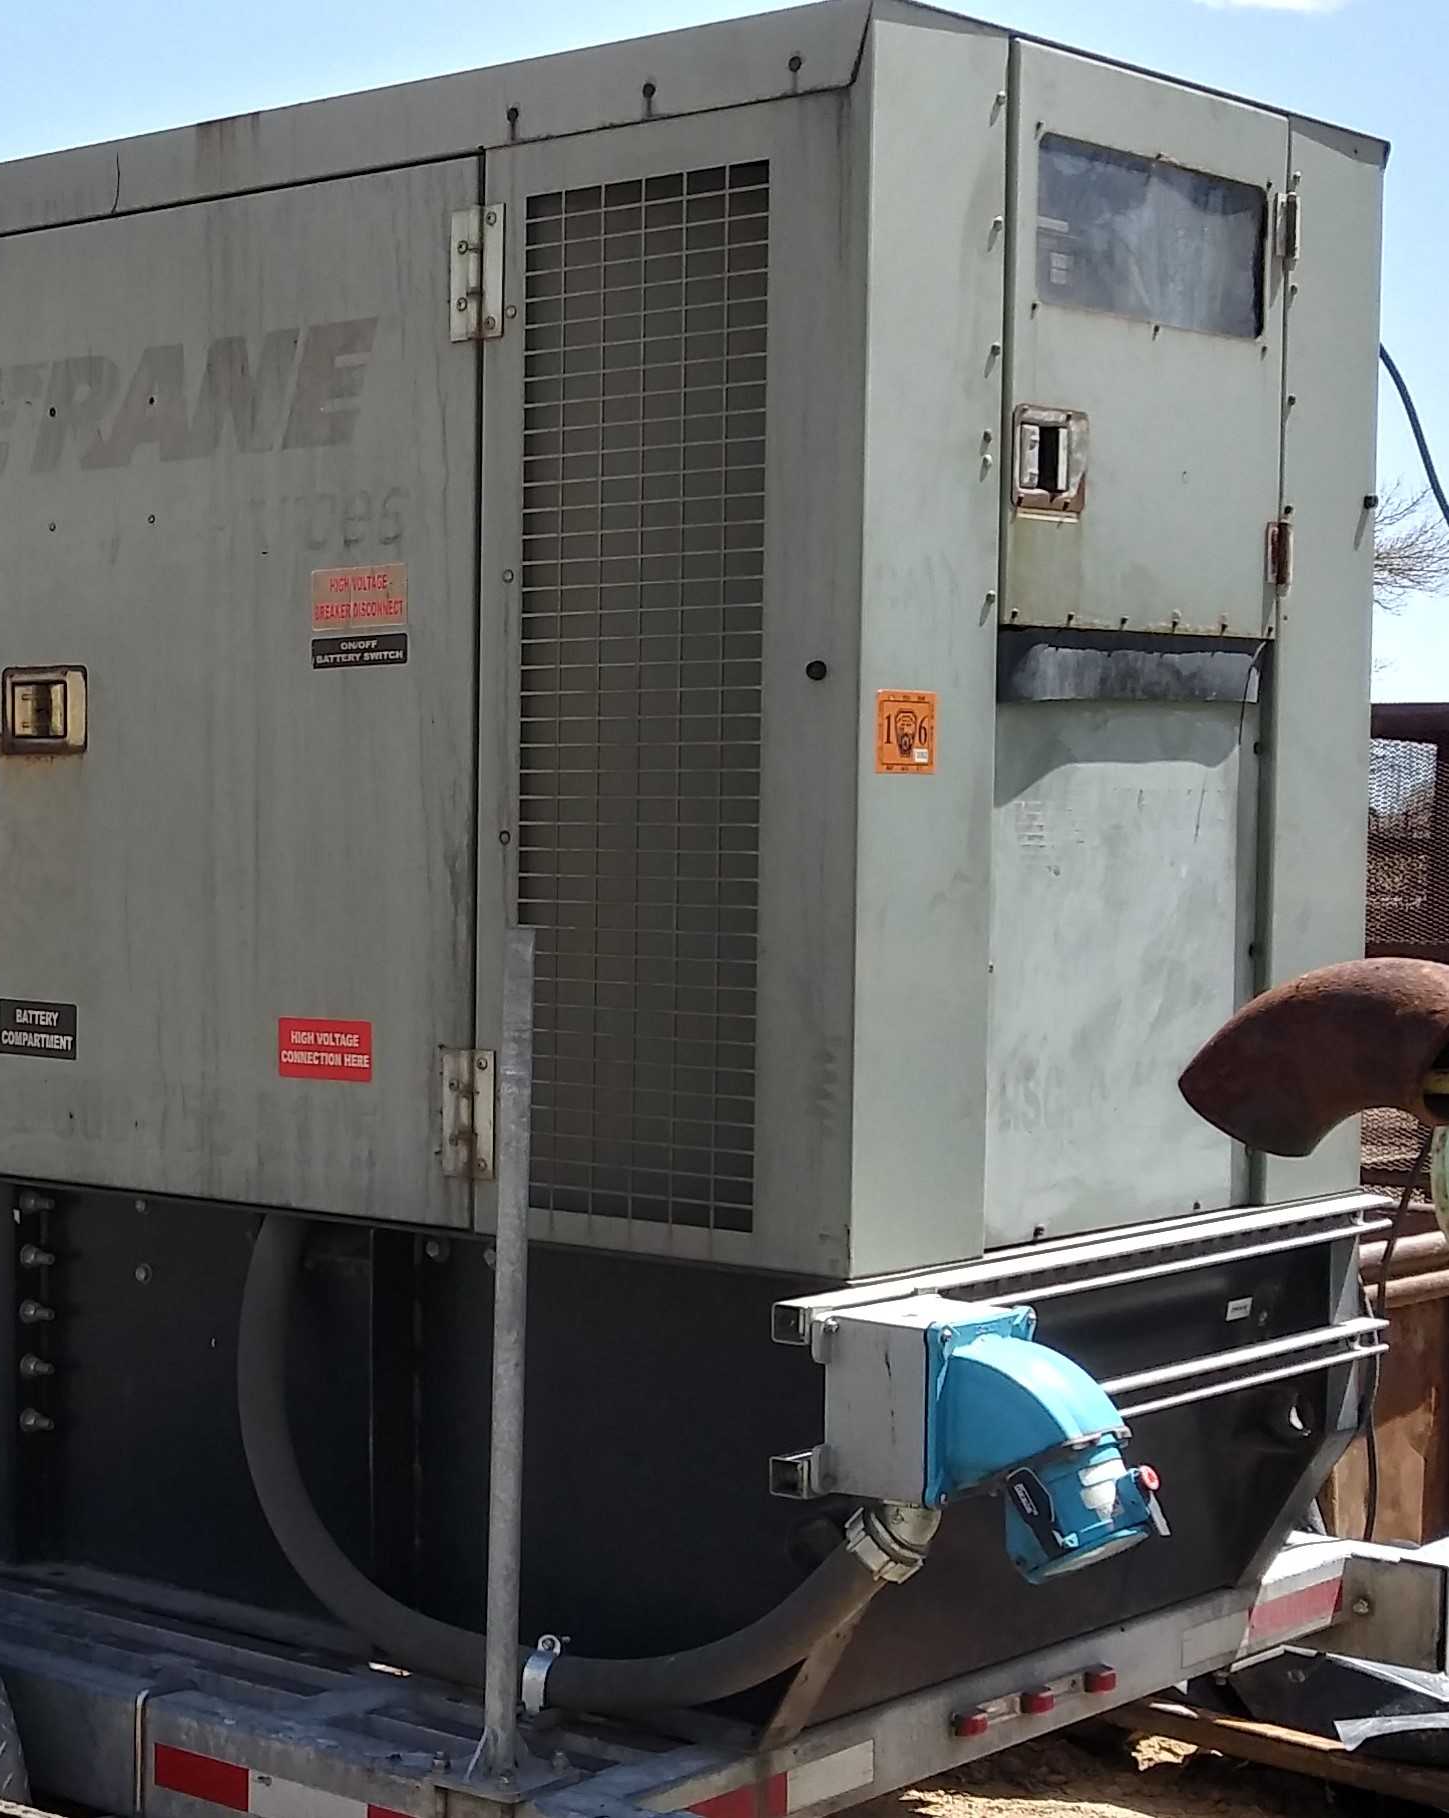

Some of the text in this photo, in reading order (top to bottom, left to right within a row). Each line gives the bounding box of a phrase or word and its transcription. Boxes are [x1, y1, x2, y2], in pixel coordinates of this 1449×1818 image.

[329, 573, 388, 592] HIGH VOLTAGE
[315, 599, 403, 620] BREAKER DISCONNECT
[340, 640, 377, 650] ON/OFF
[316, 650, 403, 664] BATTERY SWITCH
[15, 1008, 59, 1026] BATTERY
[1, 1030, 73, 1050] COMPARTMENT
[291, 1030, 359, 1047] HIGH VOLTAGE
[281, 1050, 369, 1068] CONNECTION HERE
